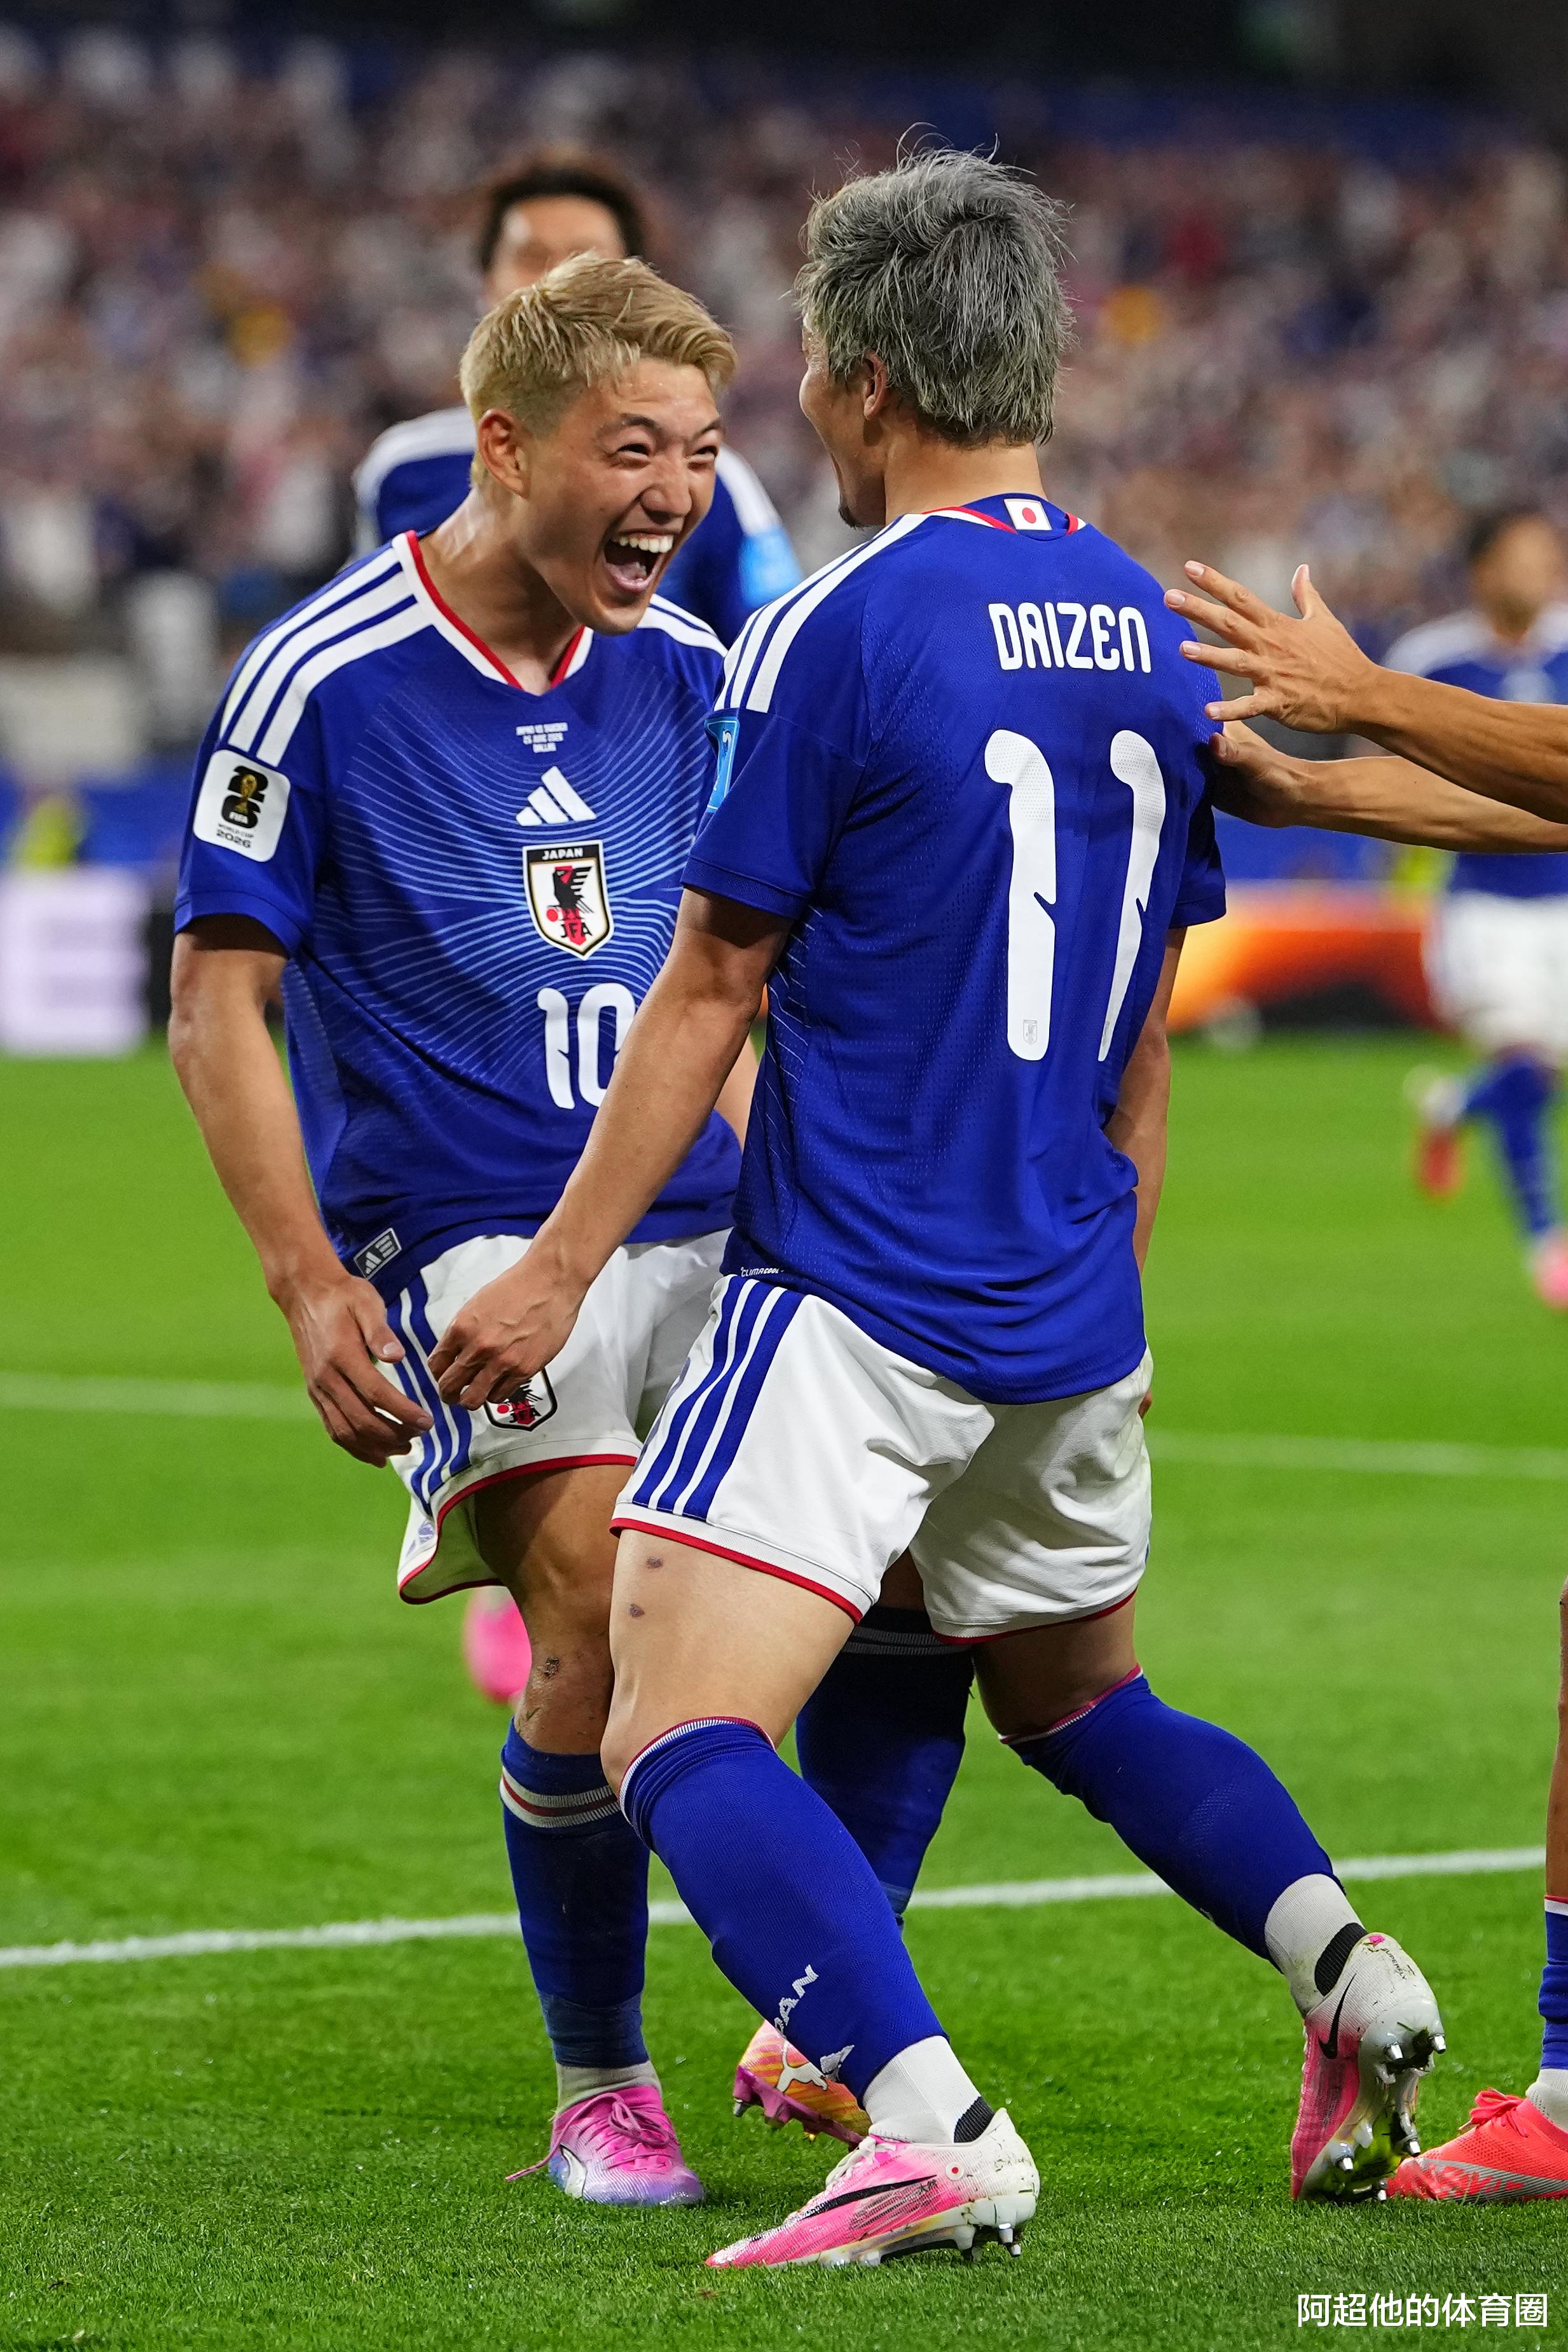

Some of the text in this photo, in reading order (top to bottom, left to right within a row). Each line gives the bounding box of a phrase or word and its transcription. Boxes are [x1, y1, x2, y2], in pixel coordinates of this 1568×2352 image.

[987, 602, 1152, 674] DAIZEN
[216, 829, 251, 848] 2026
[542, 847, 584, 861] JAPAN
[984, 728, 1167, 1063] 11
[561, 922, 592, 938] JFA
[537, 983, 635, 1109] 10
